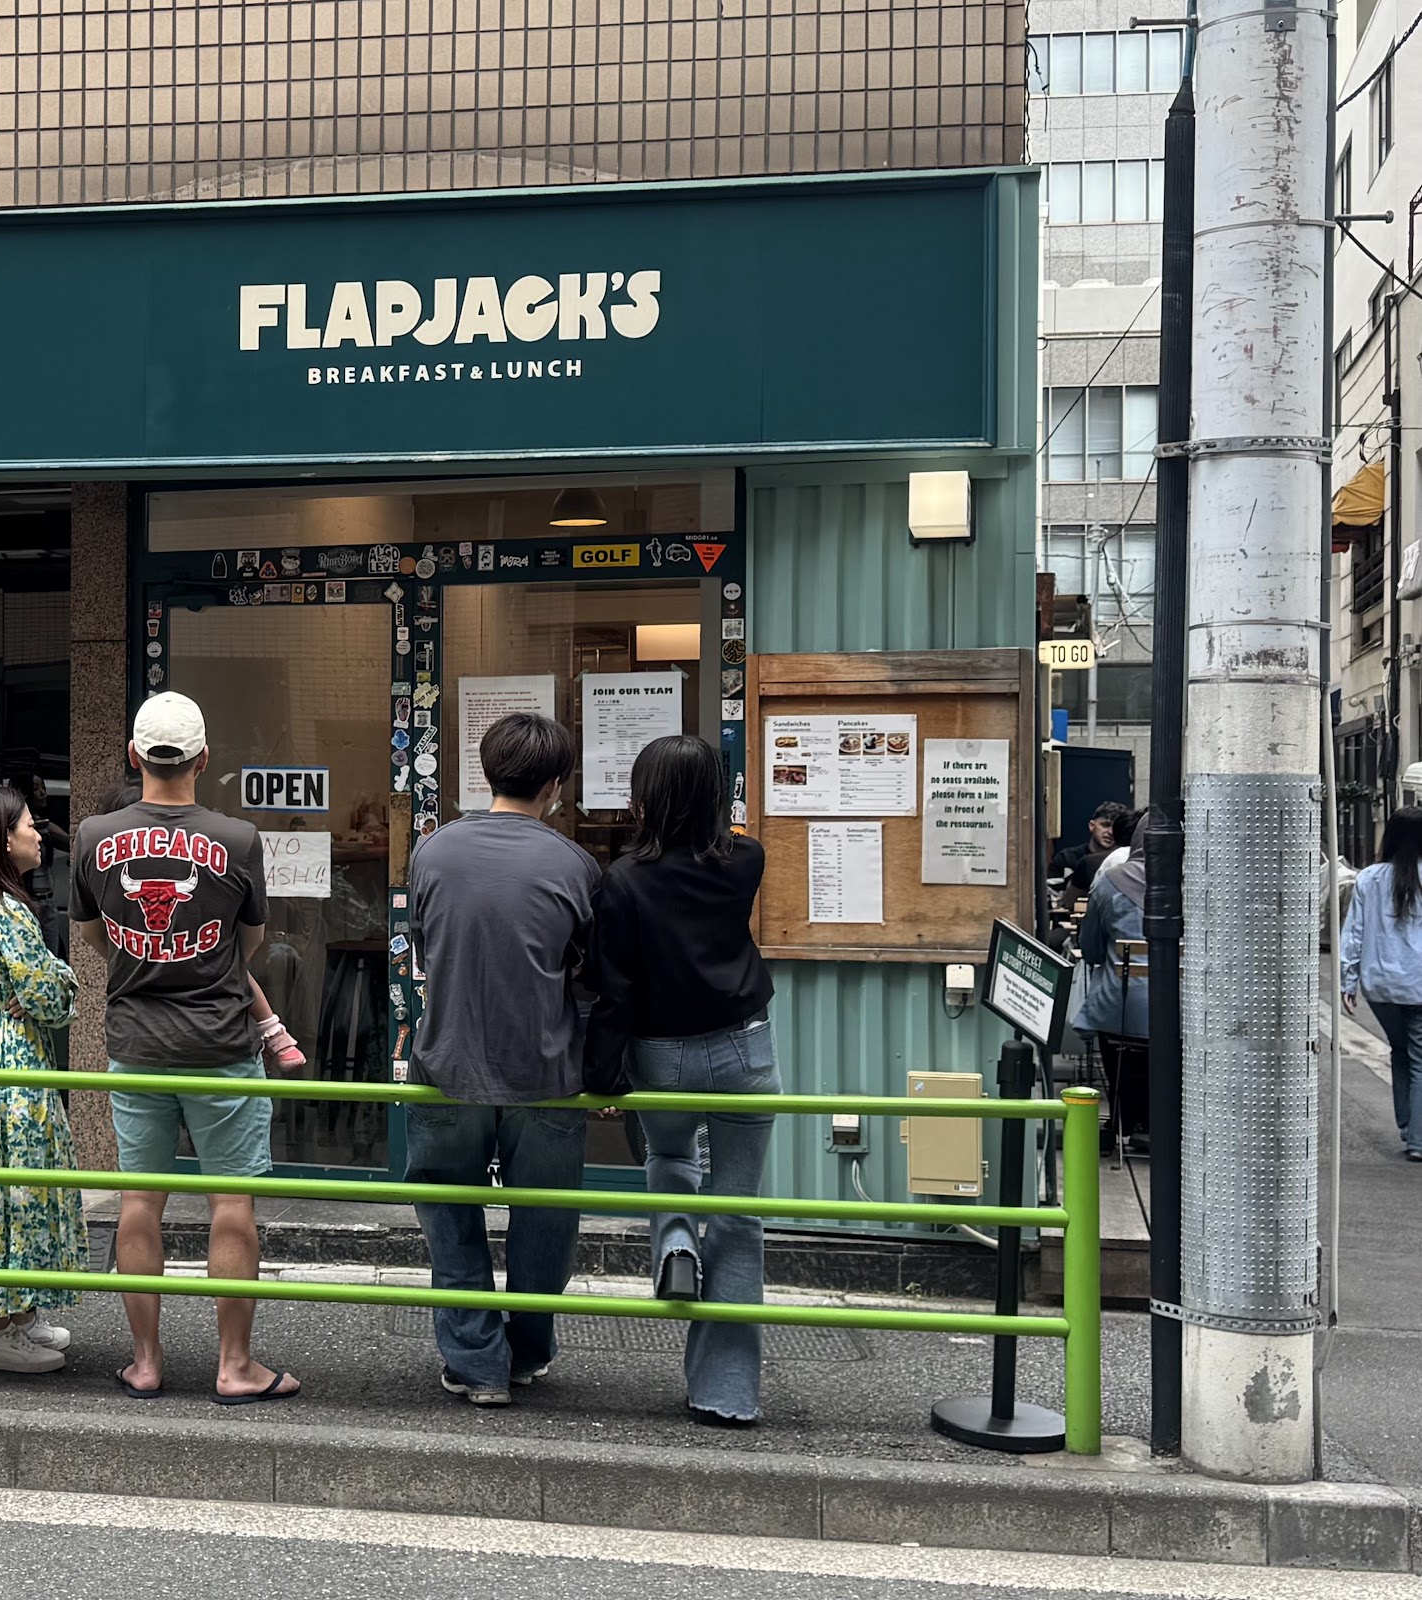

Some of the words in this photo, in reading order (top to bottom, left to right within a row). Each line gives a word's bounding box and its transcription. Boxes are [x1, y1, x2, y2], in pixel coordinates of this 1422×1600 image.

[239, 270, 660, 351] FLAPJACK'S
[580, 549, 631, 563] GOLF
[1050, 646, 1065, 663] TO
[1071, 645, 1087, 662] GO
[943, 761, 950, 769] If
[975, 762, 987, 770] are
[245, 772, 323, 806] OPEN
[932, 791, 955, 799] please
[958, 791, 975, 799] form
[984, 791, 998, 799] line
[945, 805, 952, 813] in
[955, 805, 974, 813] front
[936, 820, 948, 828] the
[950, 820, 994, 828] restaurant.
[96, 827, 228, 876] CHICAGO
[264, 837, 300, 857] NO
[265, 865, 325, 886] ASH!!
[101, 910, 222, 963] BULLS
[1017, 944, 1042, 969] RESPECT
